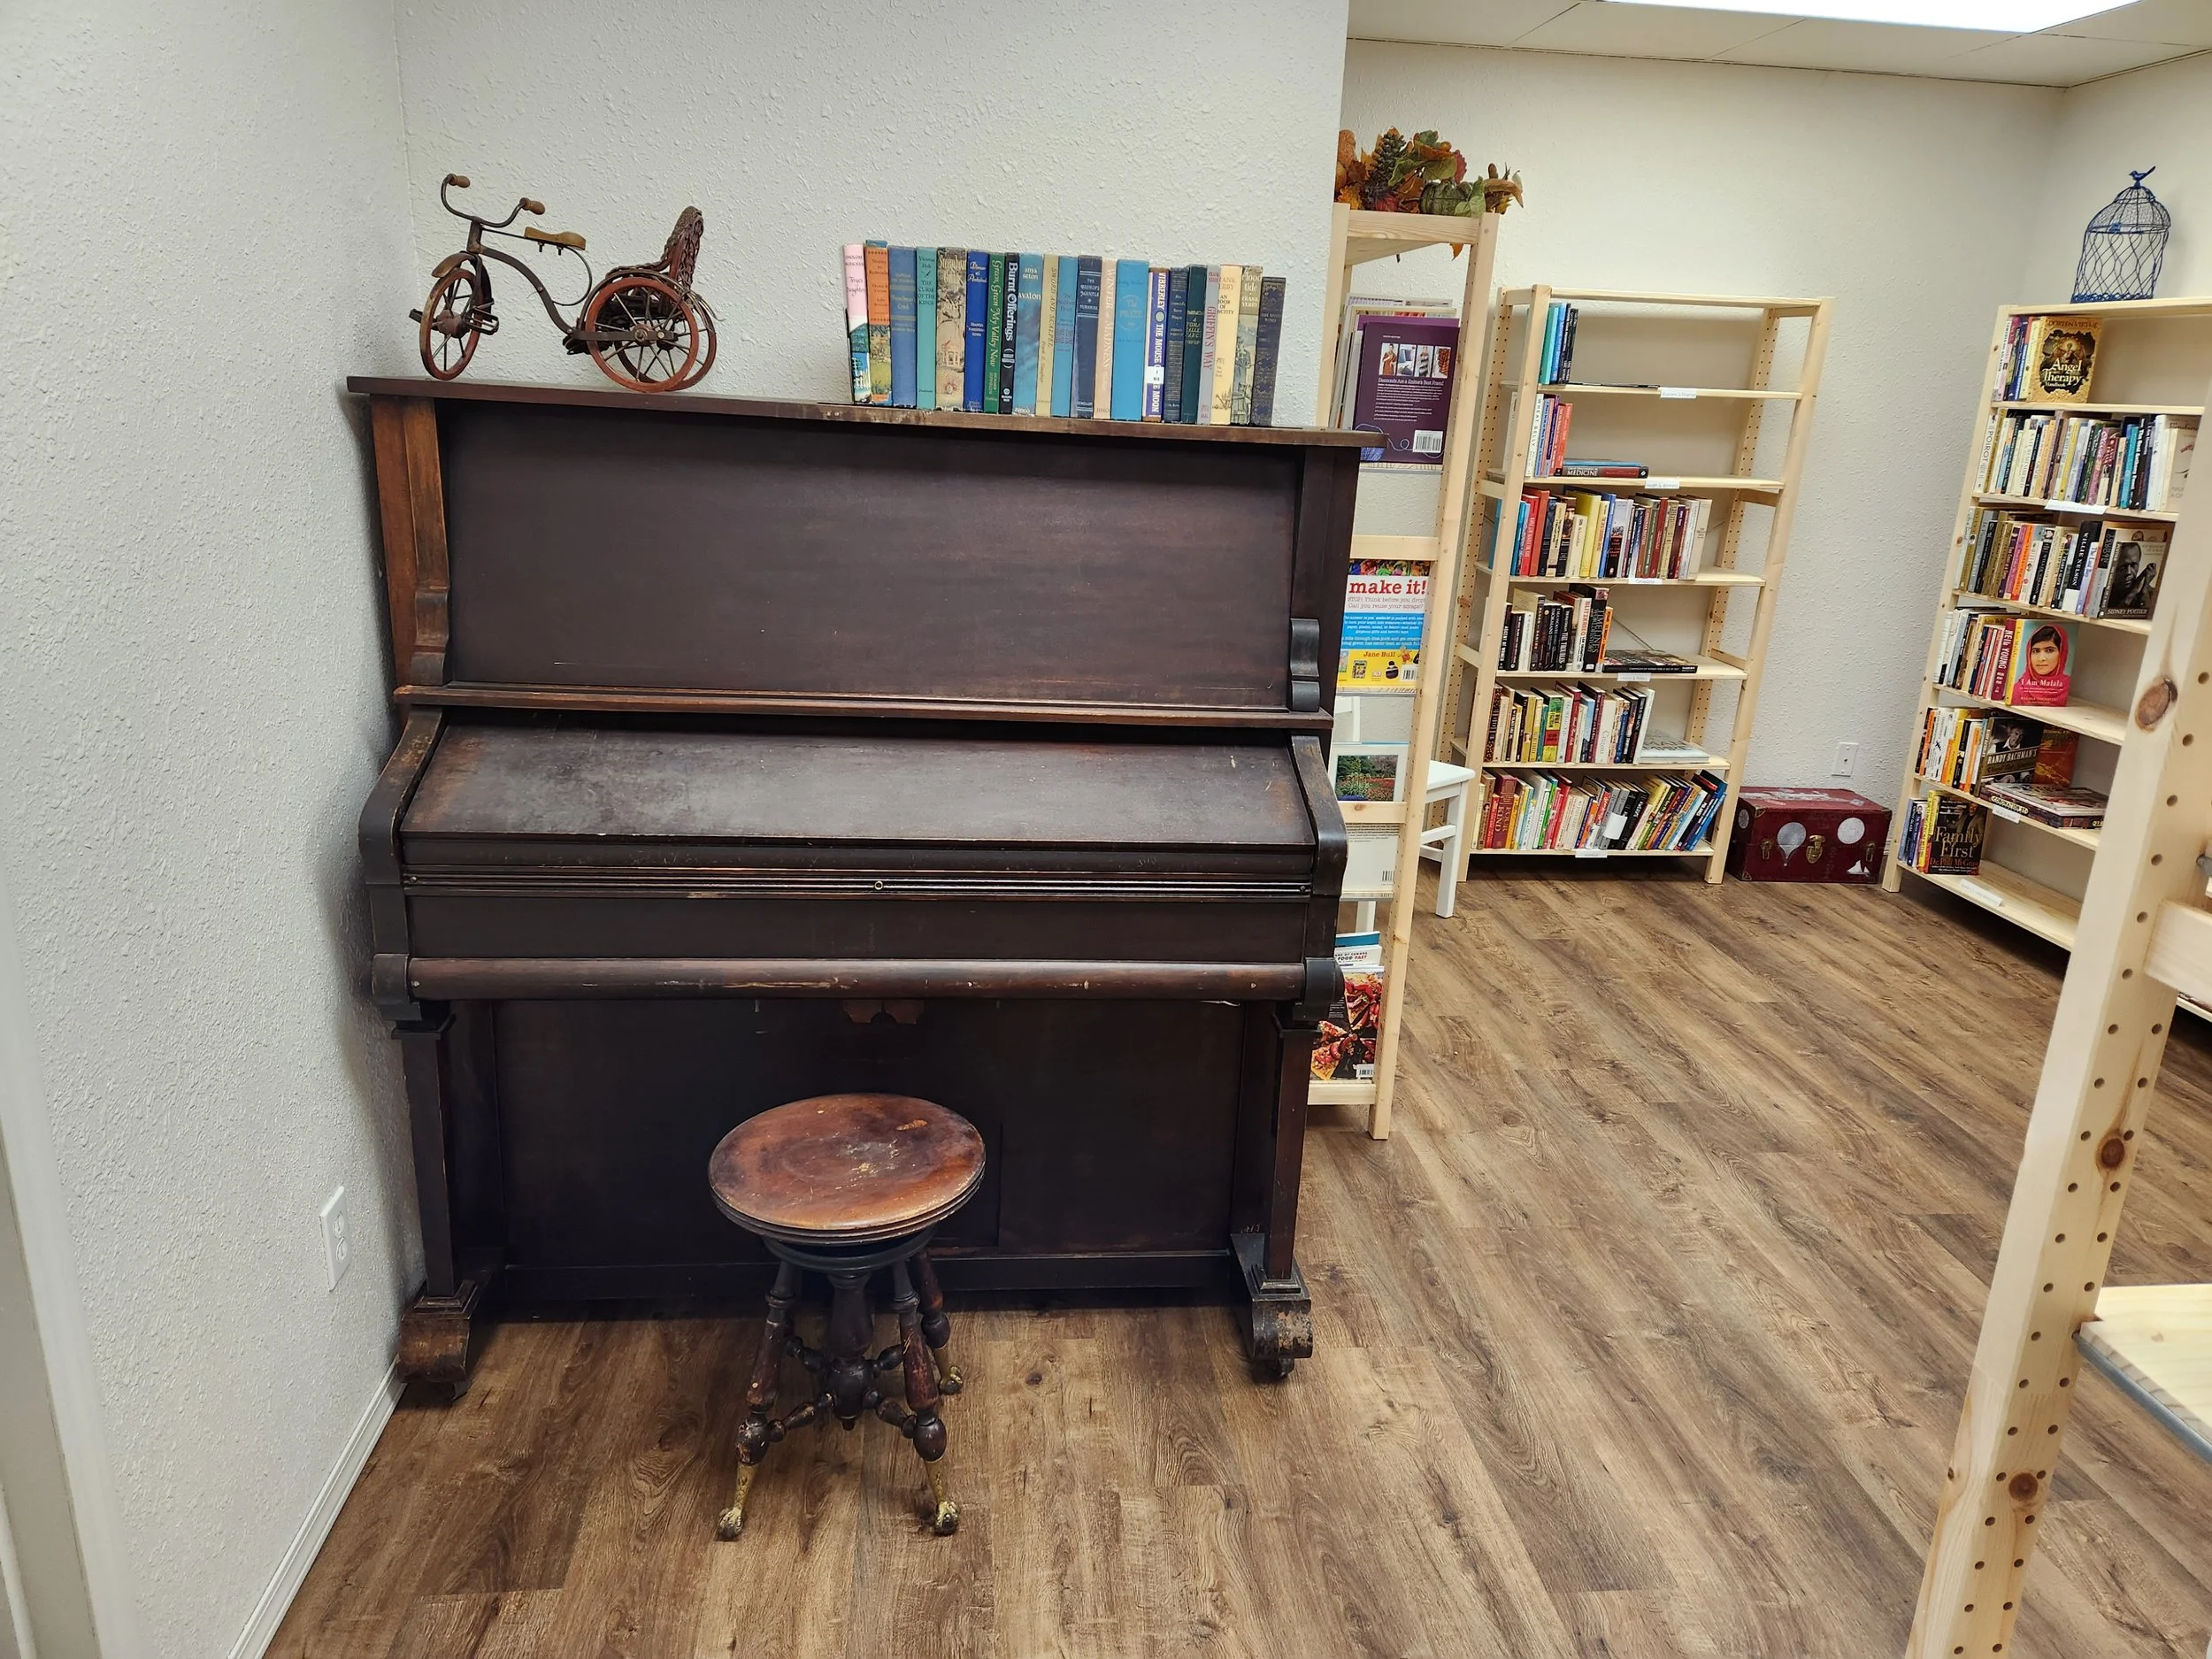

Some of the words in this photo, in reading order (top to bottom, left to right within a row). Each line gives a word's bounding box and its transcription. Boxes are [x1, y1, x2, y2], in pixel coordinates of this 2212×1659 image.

[992, 260, 1002, 284] Green,
[1008, 262, 1018, 292] Burnt
[991, 285, 1001, 307] Green
[1106, 268, 1116, 309] WINTER
[1244, 283, 1258, 292] tide
[990, 308, 1002, 326] My
[1005, 294, 1018, 342] Offerings
[1203, 306, 1217, 348] GRIFFIN'S
[988, 326, 1000, 348] Valley
[1155, 324, 1164, 338] THE
[1103, 321, 1114, 368] MADNESS
[1154, 338, 1164, 363] MOUSE
[988, 349, 998, 367] Now
[1202, 351, 1215, 370] WAY
[2051, 358, 2082, 374] Angel
[2041, 368, 2083, 386] Therapy
[1151, 390, 1161, 413] MOON
[1534, 398, 1543, 422] WHEAT
[1532, 426, 1540, 447] BELLY
[1982, 430, 1994, 461] POIROT
[2078, 532, 2089, 557] WILLIE
[2071, 558, 2083, 586] NELSON
[1348, 580, 1402, 595] make
[1406, 579, 1427, 595] it!
[1580, 601, 1592, 635] BLITZKRIEG
[1592, 609, 1605, 653] TIMELINES
[2002, 630, 2014, 646] NEIL
[1558, 642, 1568, 664] TROUBLES
[1998, 648, 2010, 669] YOUNG
[1600, 730, 1609, 755] Citizens
[1987, 752, 2008, 764] RANDY
[2007, 749, 2038, 763] BACHMAN'S
[1993, 797, 2018, 811] CORONATION
[1494, 806, 1504, 833] KIND
[1502, 806, 1512, 832] FOUR
[1935, 826, 1983, 848] Family
[1941, 841, 1975, 858] First
[1939, 857, 1953, 866] Phil
